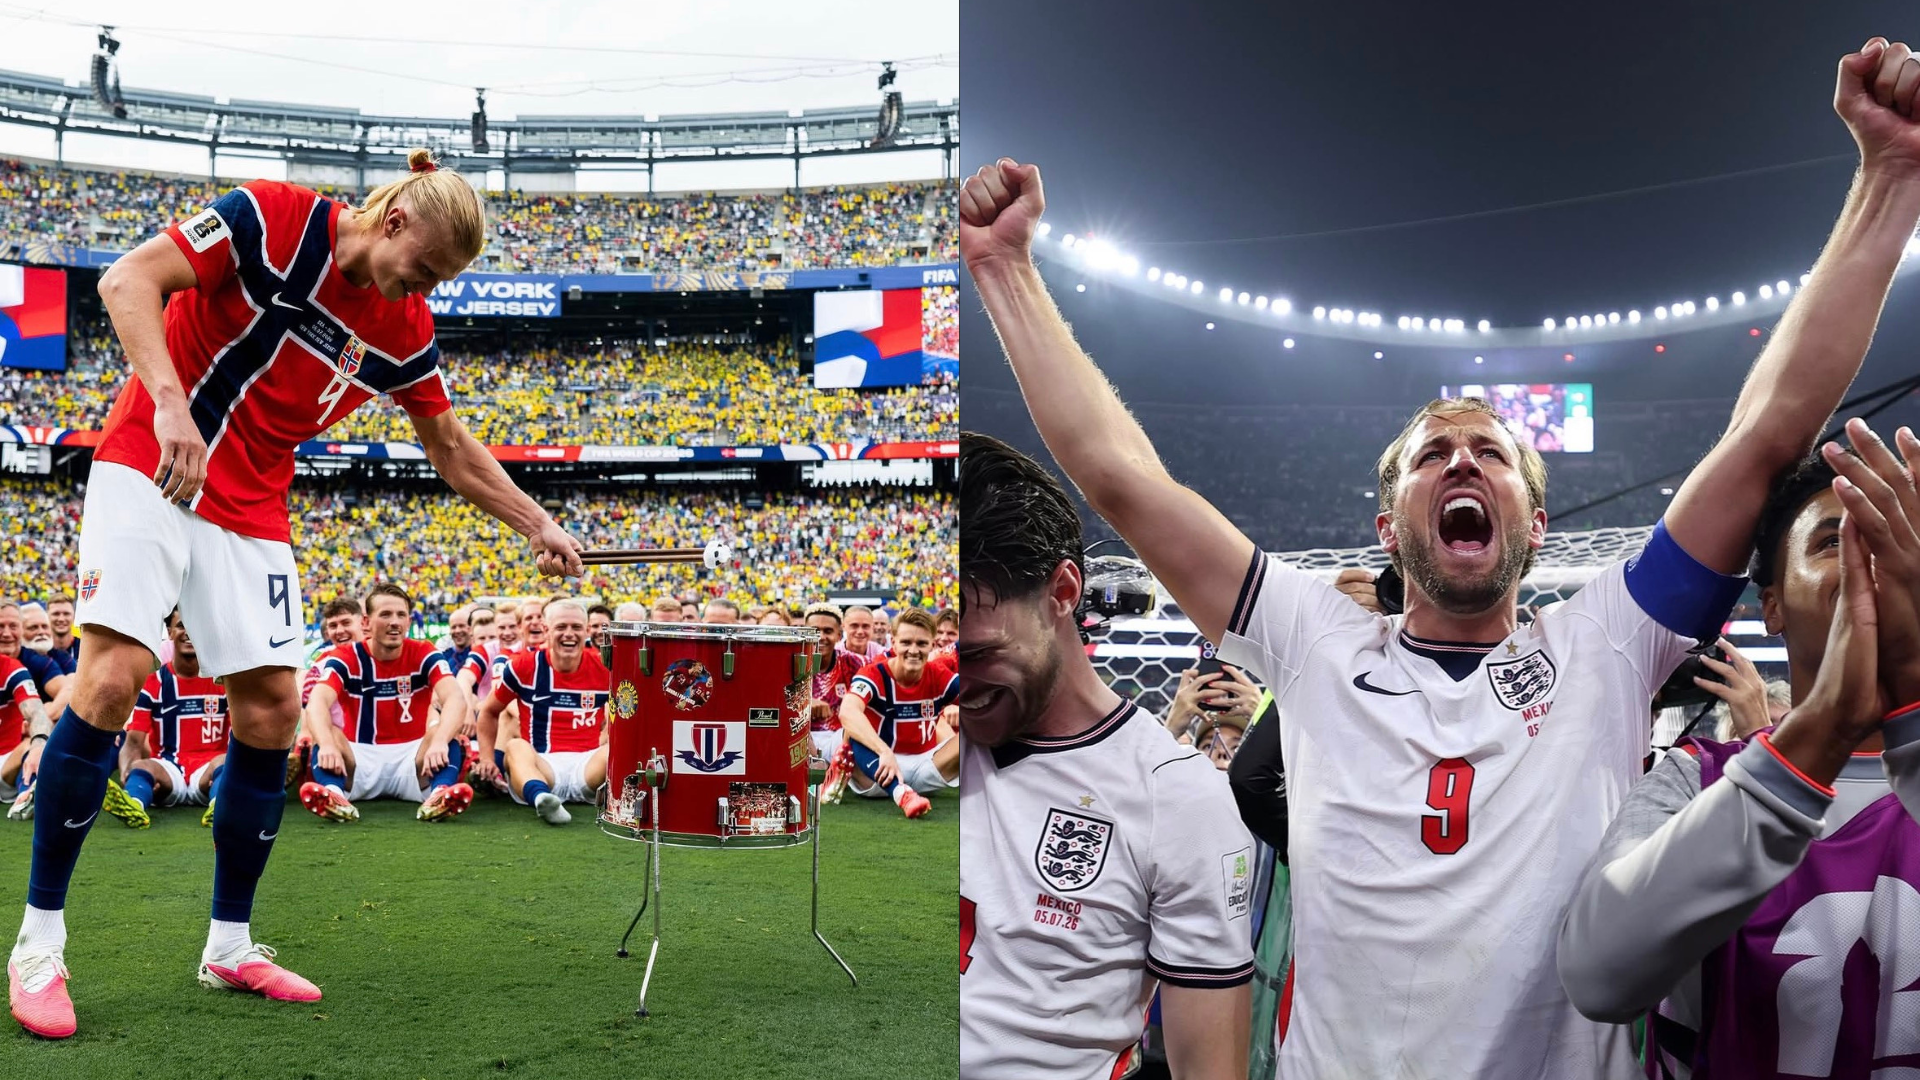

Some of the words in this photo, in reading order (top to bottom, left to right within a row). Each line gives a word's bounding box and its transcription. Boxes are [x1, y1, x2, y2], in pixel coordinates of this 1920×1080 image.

[923, 268, 957, 284] FIFA
[471, 282, 556, 299] YORK
[456, 301, 556, 316] JERSEY
[316, 373, 350, 426] 9
[267, 573, 291, 626] 9
[398, 698, 414, 723] 8
[1521, 701, 1551, 722] MEXI
[202, 717, 224, 744] 22
[918, 720, 937, 745] 10
[1421, 756, 1475, 855] 9
[1037, 893, 1082, 915] MEXICO
[1034, 909, 1079, 931] 05.07.26
